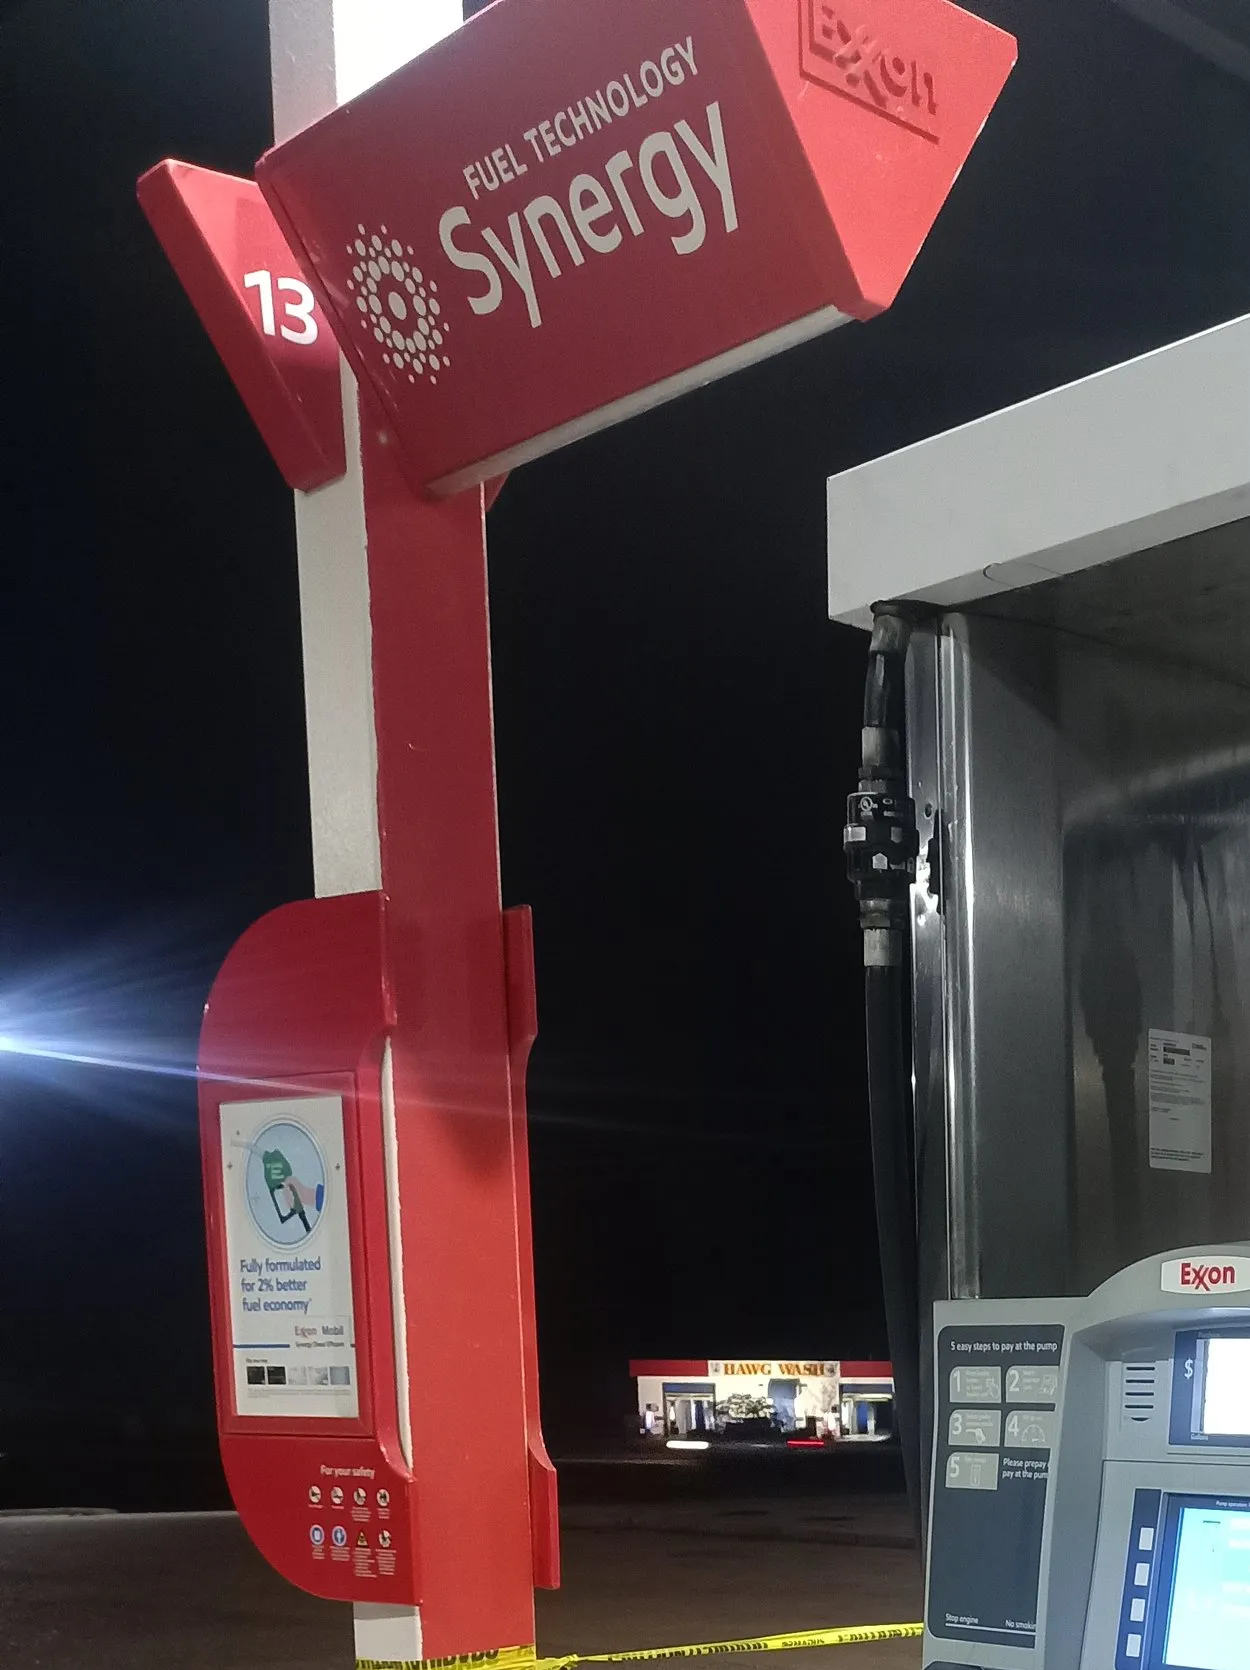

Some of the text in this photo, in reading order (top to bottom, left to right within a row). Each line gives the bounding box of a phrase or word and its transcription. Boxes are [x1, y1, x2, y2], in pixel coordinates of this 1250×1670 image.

[463, 35, 698, 200] FUEL TECHNOLOGY
[438, 100, 739, 328] Synergy
[243, 270, 318, 346] 13
[240, 1256, 321, 1276] Fully formulated
[241, 1278, 307, 1292] for 2% better
[1180, 1262, 1235, 1291] Exxon
[243, 1298, 261, 1311] fuel
[950, 1340, 1058, 1354] 5 easy steps to pay at the pump
[723, 1363, 825, 1376] HAWG WASH
[1184, 1359, 1193, 1379] $
[952, 1370, 961, 1393] 1
[1009, 1370, 1020, 1392] 2
[951, 1413, 963, 1435] 3
[1007, 1415, 1019, 1437] 4
[949, 1456, 960, 1478] 5
[1002, 1468, 1049, 1480] pay at the pum
[1003, 1457, 1047, 1472] Please prepay
[945, 1613, 979, 1625] Stop engine
[1005, 1619, 1036, 1630] No smokin
